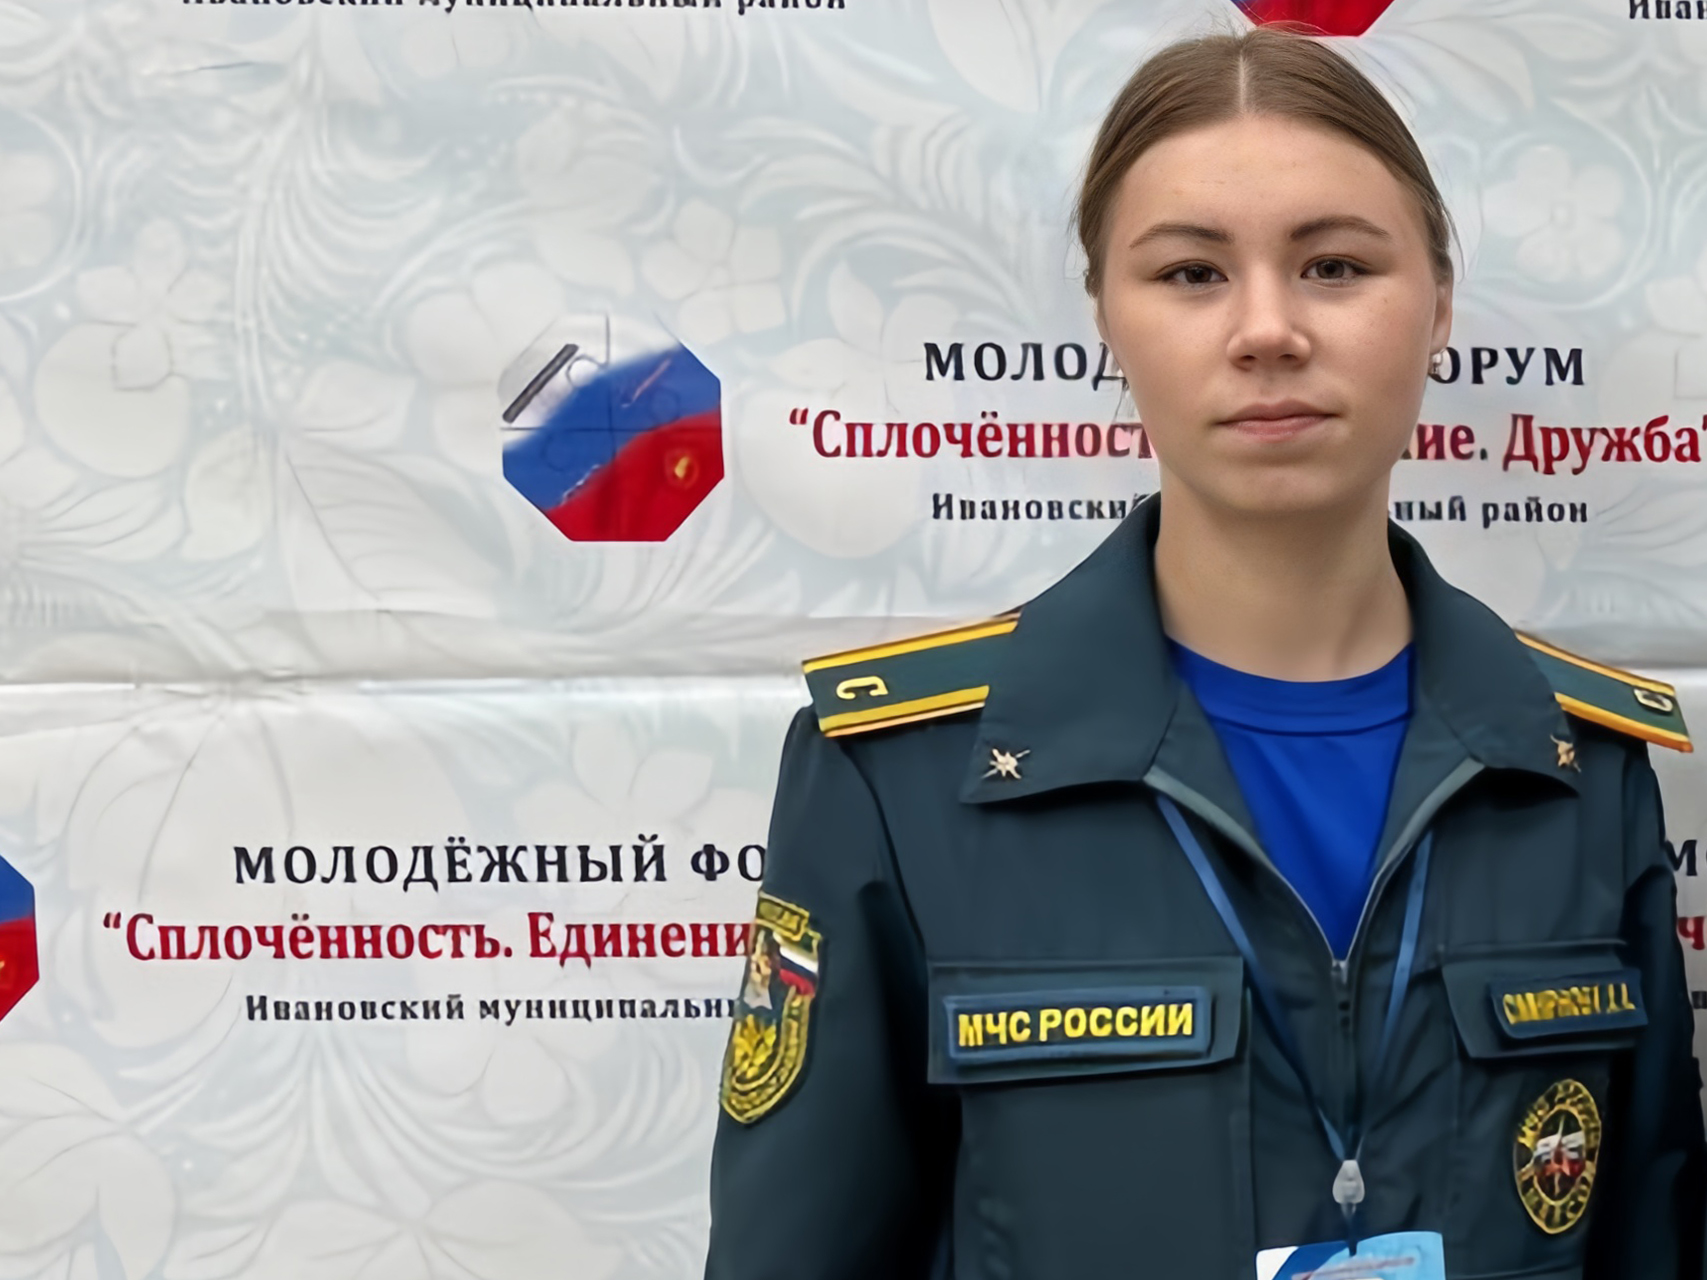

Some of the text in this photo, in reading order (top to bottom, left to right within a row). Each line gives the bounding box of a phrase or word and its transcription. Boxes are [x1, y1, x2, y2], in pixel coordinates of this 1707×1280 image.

[923, 342, 1585, 392] МОЛОД ОРУМ
[788, 404, 1153, 462] “Сплочённост
[1482, 497, 1587, 529] район
[234, 834, 766, 892] МОЛОДЁЖНЫЙ ФО
[527, 910, 752, 966] Единени
[246, 994, 464, 1020] Ивановский
[958, 1002, 1193, 1047] МЧС РОССИИ
